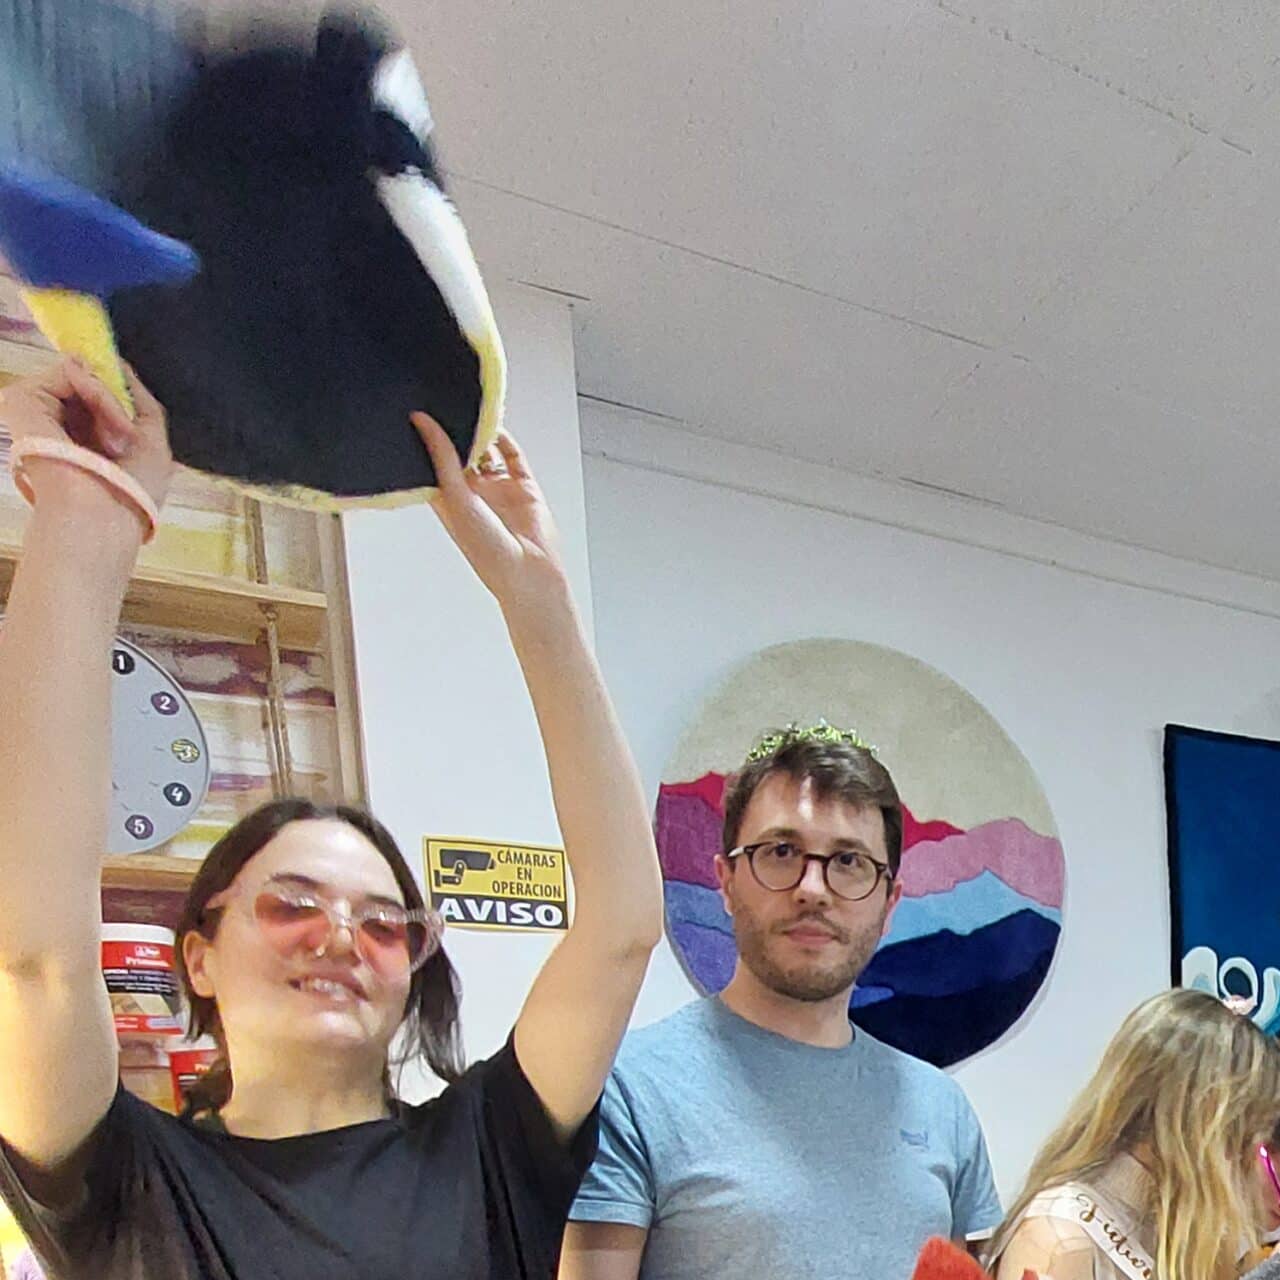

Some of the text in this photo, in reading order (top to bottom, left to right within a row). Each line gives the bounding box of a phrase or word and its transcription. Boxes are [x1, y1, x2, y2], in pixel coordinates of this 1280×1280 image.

[117, 655, 125, 669] 1
[160, 696, 170, 710] 2
[180, 745, 192, 760] 3
[172, 787, 183, 802] 4
[134, 819, 145, 834] 5
[497, 849, 556, 868] CÁMARAS
[517, 867, 532, 881] EN
[492, 880, 562, 898] OPERACION
[438, 897, 563, 926] AVISO
